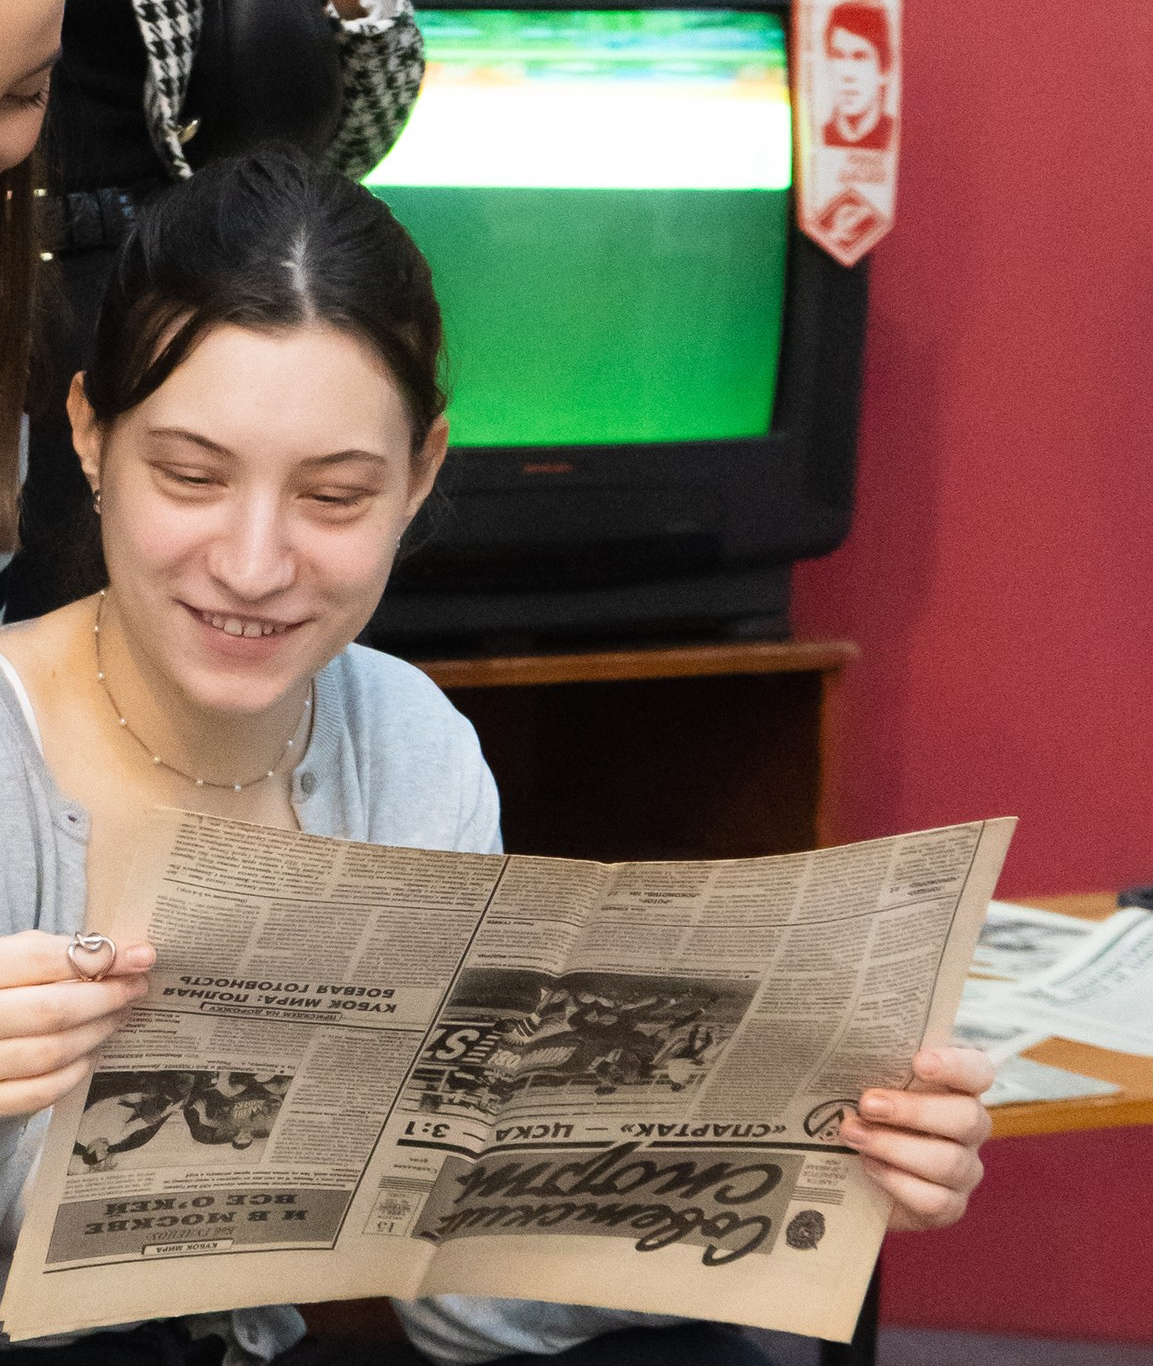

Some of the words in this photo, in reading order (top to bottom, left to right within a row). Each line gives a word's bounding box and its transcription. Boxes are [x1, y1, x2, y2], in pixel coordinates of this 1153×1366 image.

[179, 975, 310, 994] ГОТОВНОСТЬ
[316, 985, 395, 998] БОЕВАЯ
[162, 987, 249, 1003] ПОЛНАЯ
[256, 995, 322, 1009] МИРА:
[208, 1006, 262, 1016] ДОРОЖКУ
[329, 999, 397, 1013] КУБОК
[283, 1011, 337, 1021] ПРИСЯДЕМ
[403, 1120, 451, 1140] 3:1
[494, 1122, 575, 1143] ЦСКА
[619, 1122, 788, 1140] «СПАРТАК»
[226, 1194, 298, 1206] ВСЕ
[247, 1210, 271, 1221] В
[282, 1210, 308, 1221] И
[84, 1211, 238, 1235] МОСКВЕ
[417, 1202, 772, 1268] Советский
[155, 1244, 183, 1254] МИРА
[185, 1242, 218, 1251] КУБОК
